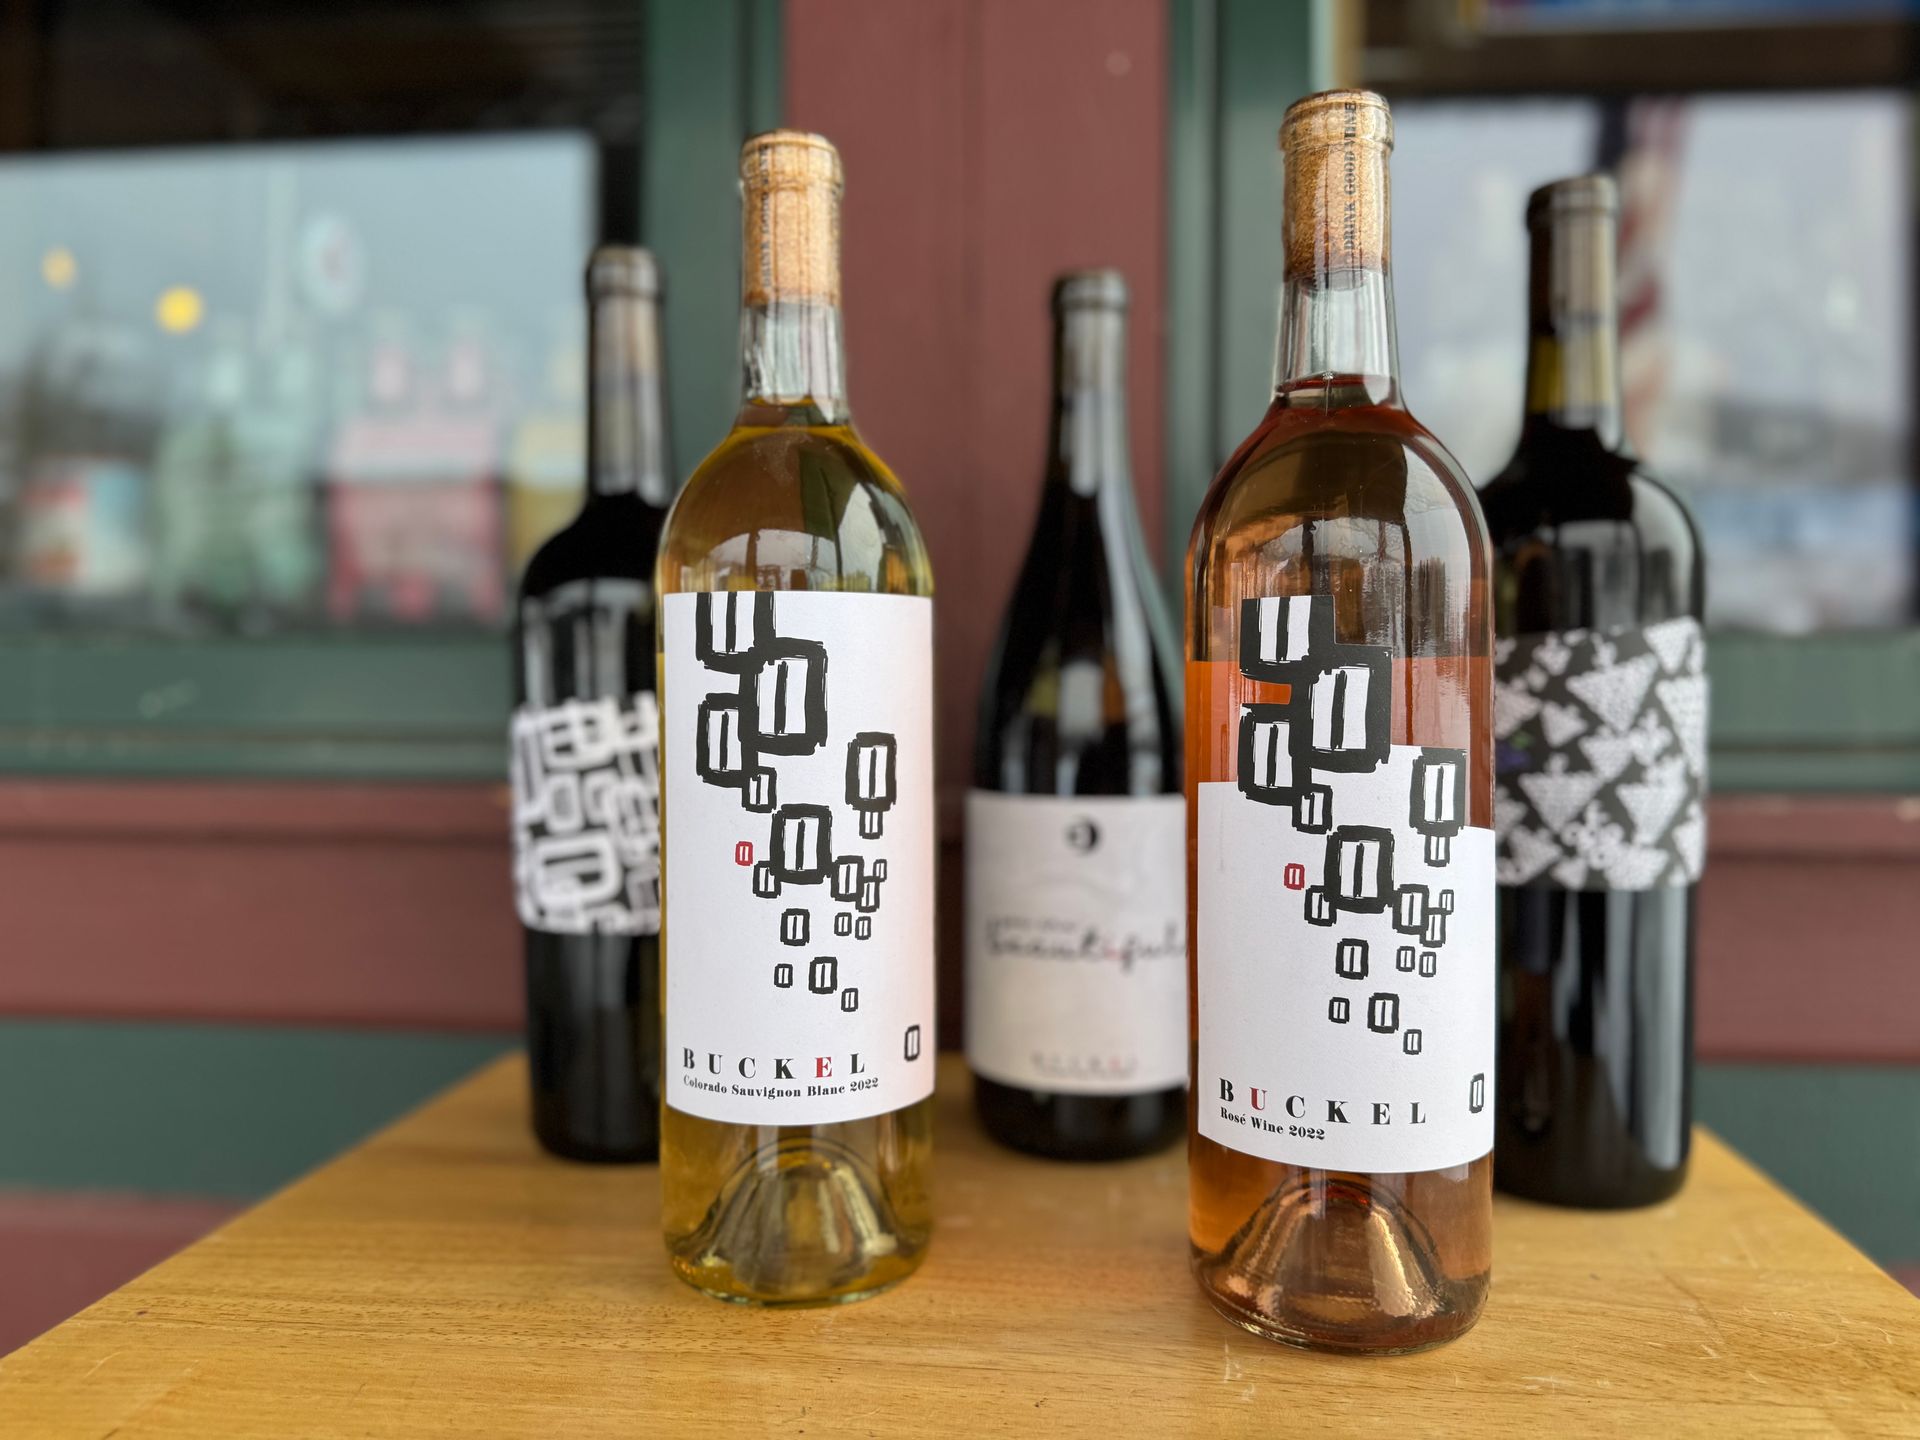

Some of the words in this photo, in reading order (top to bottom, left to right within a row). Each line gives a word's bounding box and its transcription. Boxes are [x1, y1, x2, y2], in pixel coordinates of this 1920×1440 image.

[1344, 151, 1356, 195] GOOD
[1344, 201, 1356, 250] DRINK
[683, 1047, 865, 1079] BUCKEL
[683, 1075, 727, 1094] Colorado
[731, 1084, 800, 1100] Sauvignon
[807, 1085, 845, 1097] Blanc
[849, 1077, 879, 1092] 2022
[1219, 1077, 1427, 1125] BUCKEL
[1220, 1106, 1246, 1126] Rosé
[1251, 1116, 1284, 1135] Wine
[1288, 1125, 1326, 1141] 2022
